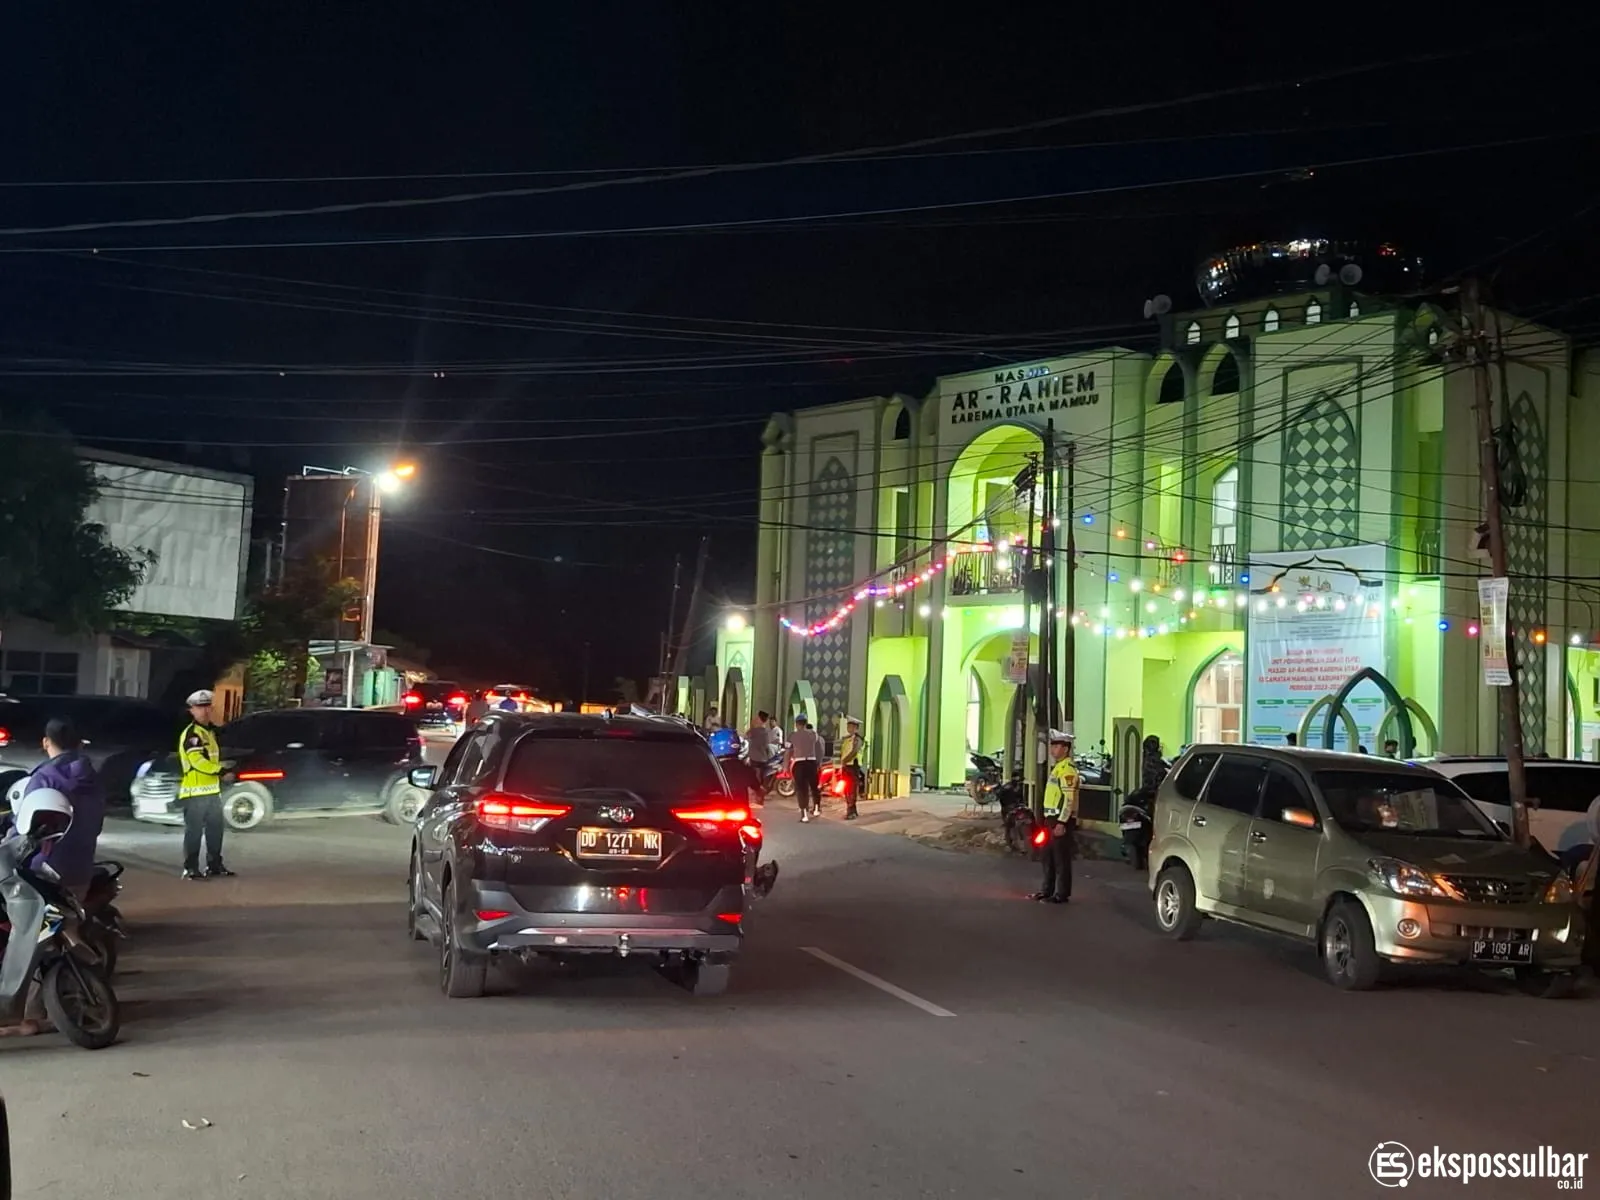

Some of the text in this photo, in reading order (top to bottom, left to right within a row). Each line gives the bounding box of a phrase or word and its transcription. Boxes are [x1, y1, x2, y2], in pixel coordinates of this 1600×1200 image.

[951, 393, 1099, 424] KAREMA UTARA MAMUJU
[953, 390, 978, 411] AR
[581, 832, 658, 849] DD 1271 NK
[1474, 941, 1530, 956] DP 1091 AR
